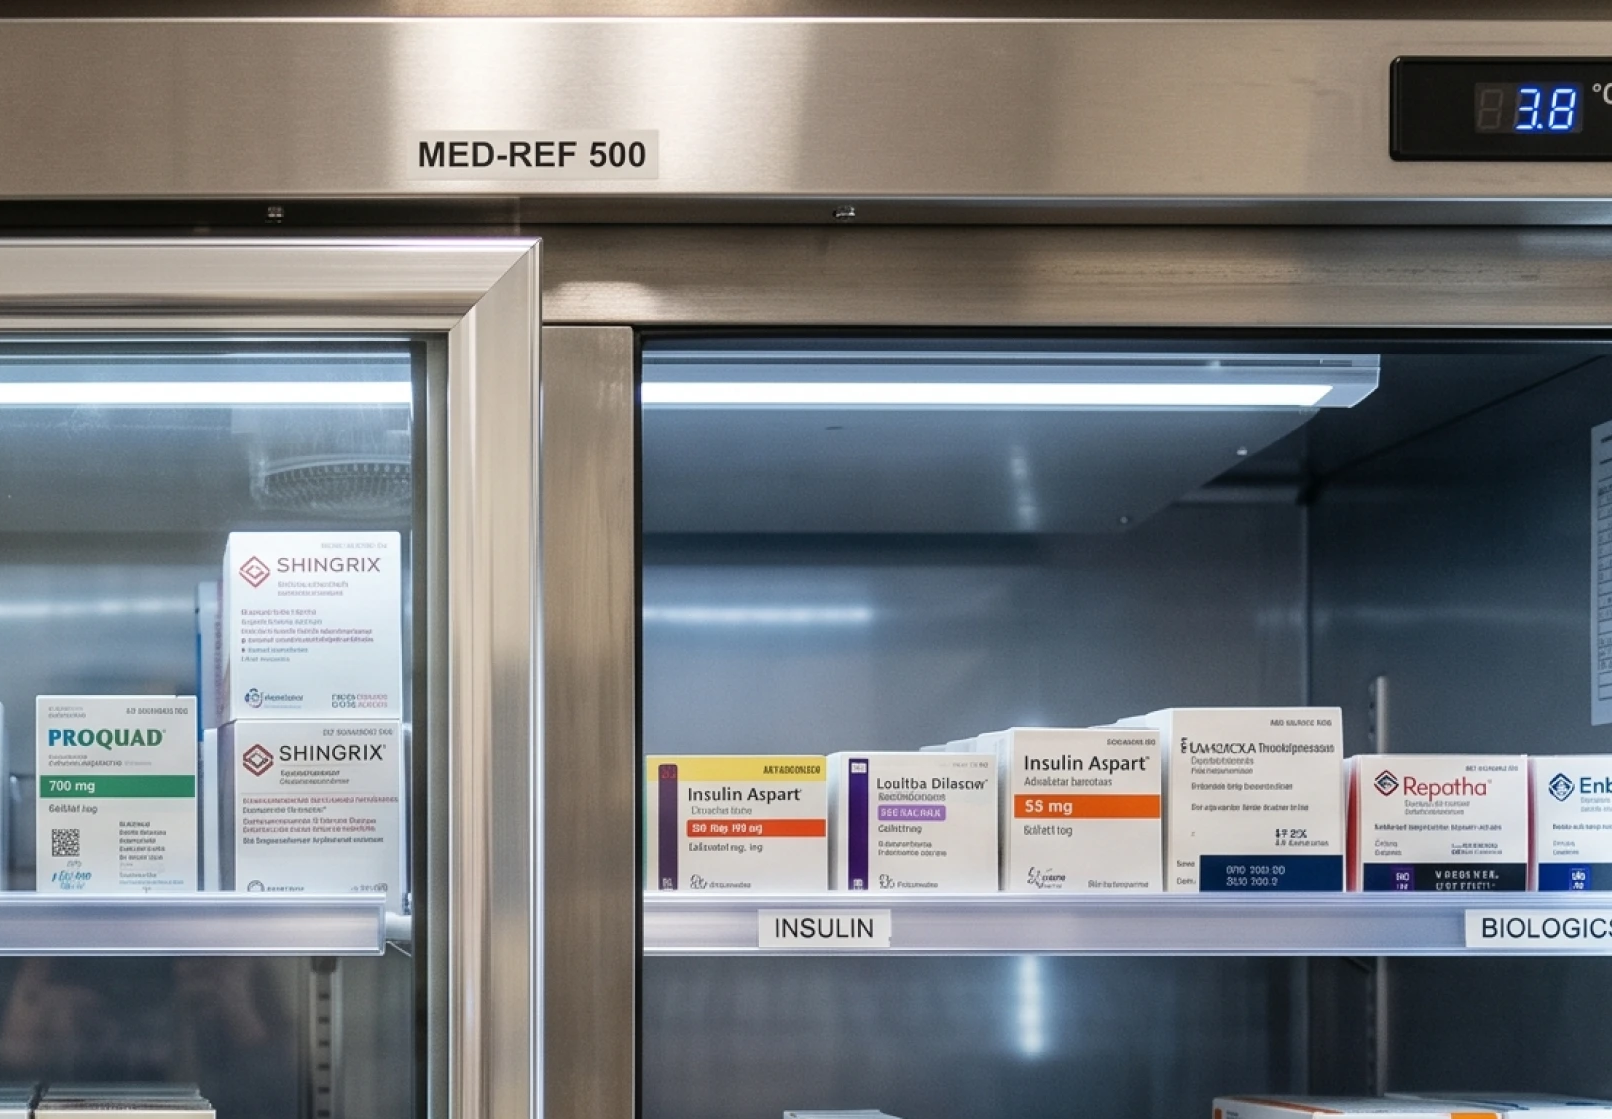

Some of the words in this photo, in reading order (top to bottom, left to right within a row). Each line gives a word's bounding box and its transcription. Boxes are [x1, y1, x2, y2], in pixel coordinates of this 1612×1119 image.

[1515, 87, 1577, 130] 3.8
[418, 141, 578, 168] MED-REF
[589, 141, 647, 168] 500
[276, 557, 382, 573] SHINGRIX
[48, 728, 163, 750] PROQUAD
[279, 744, 384, 762] SHINGRIX
[1024, 754, 1084, 771] Insulin
[1088, 755, 1146, 775] Aspart
[48, 780, 72, 792] 700
[75, 782, 96, 794] mg
[687, 786, 743, 801] Insulin
[746, 786, 800, 804] Aspart
[1402, 776, 1488, 801] Repatha
[1048, 801, 1074, 816] mg
[775, 917, 874, 938] INSULIN
